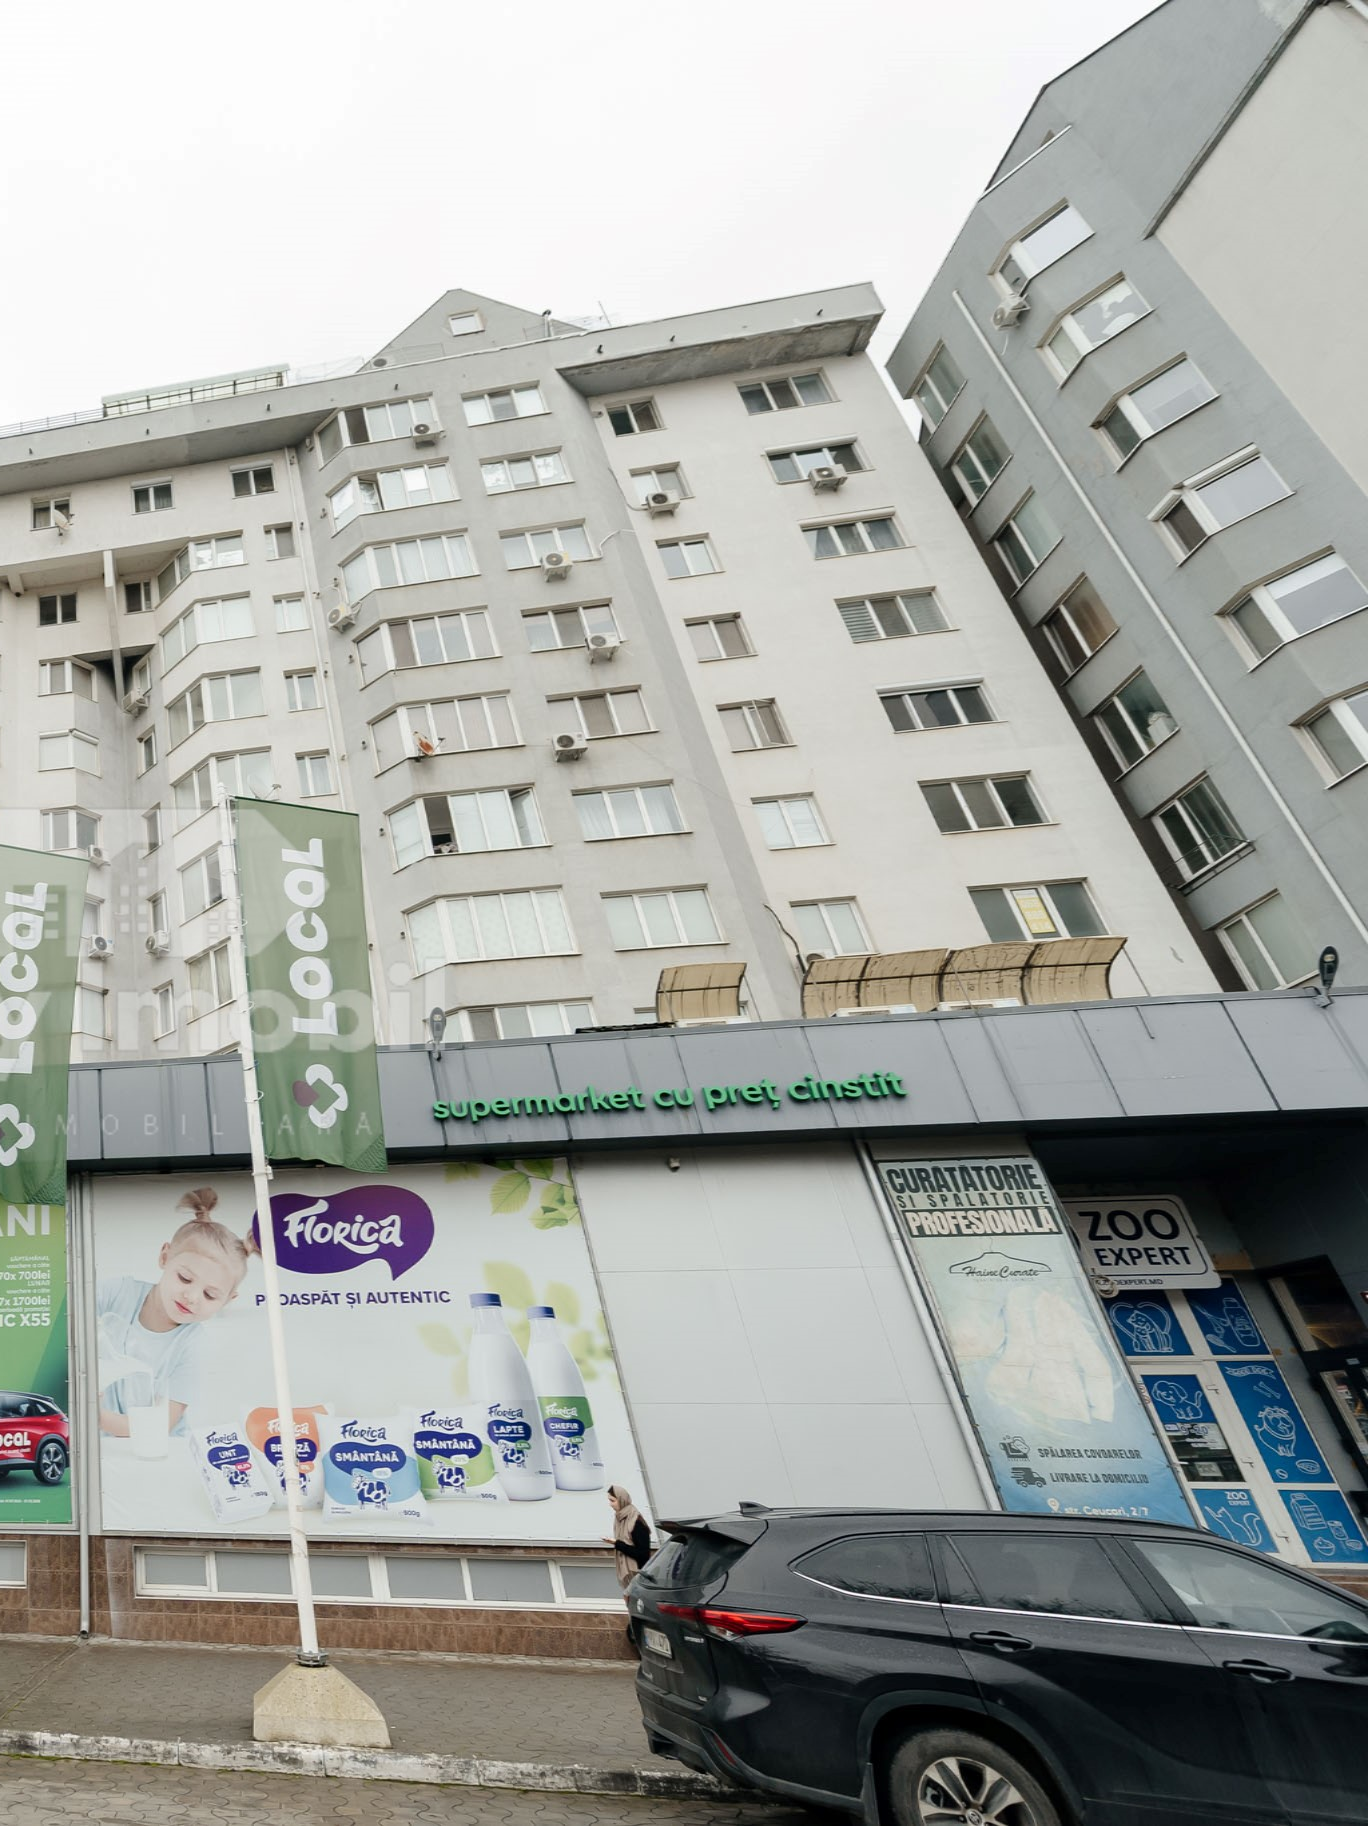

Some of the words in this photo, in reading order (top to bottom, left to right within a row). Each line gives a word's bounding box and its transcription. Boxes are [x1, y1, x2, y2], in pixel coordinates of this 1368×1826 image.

[282, 838, 338, 1036] LOCAL
[433, 1085, 646, 1123] supermarket
[653, 1089, 694, 1108] cu
[702, 1079, 781, 1112] preț
[787, 1071, 908, 1101] cinstit
[283, 1199, 404, 1255] Florica
[905, 1206, 1059, 1236] PROFESIONALĂ
[1078, 1208, 1181, 1241] ZOO
[1094, 1247, 1192, 1267] EXPERT
[18, 1270, 50, 1280] 700lei
[255, 1290, 341, 1306] POASPĂT
[346, 1292, 362, 1309] ȘI
[365, 1291, 451, 1305] AUTENTIC
[20, 1313, 50, 1327] X55
[487, 1403, 524, 1420] Florica
[544, 1402, 578, 1418] Florica
[420, 1410, 463, 1431] Florica
[340, 1420, 387, 1442] Florica
[493, 1425, 524, 1434] LAPTE
[270, 1442, 311, 1452] BRZĂ
[415, 1438, 476, 1450] SMÂNTÂNĂ
[218, 1448, 237, 1459] UNT
[335, 1450, 399, 1462] SMÂNTÂNĂ
[1224, 1491, 1249, 1500] ZOO
